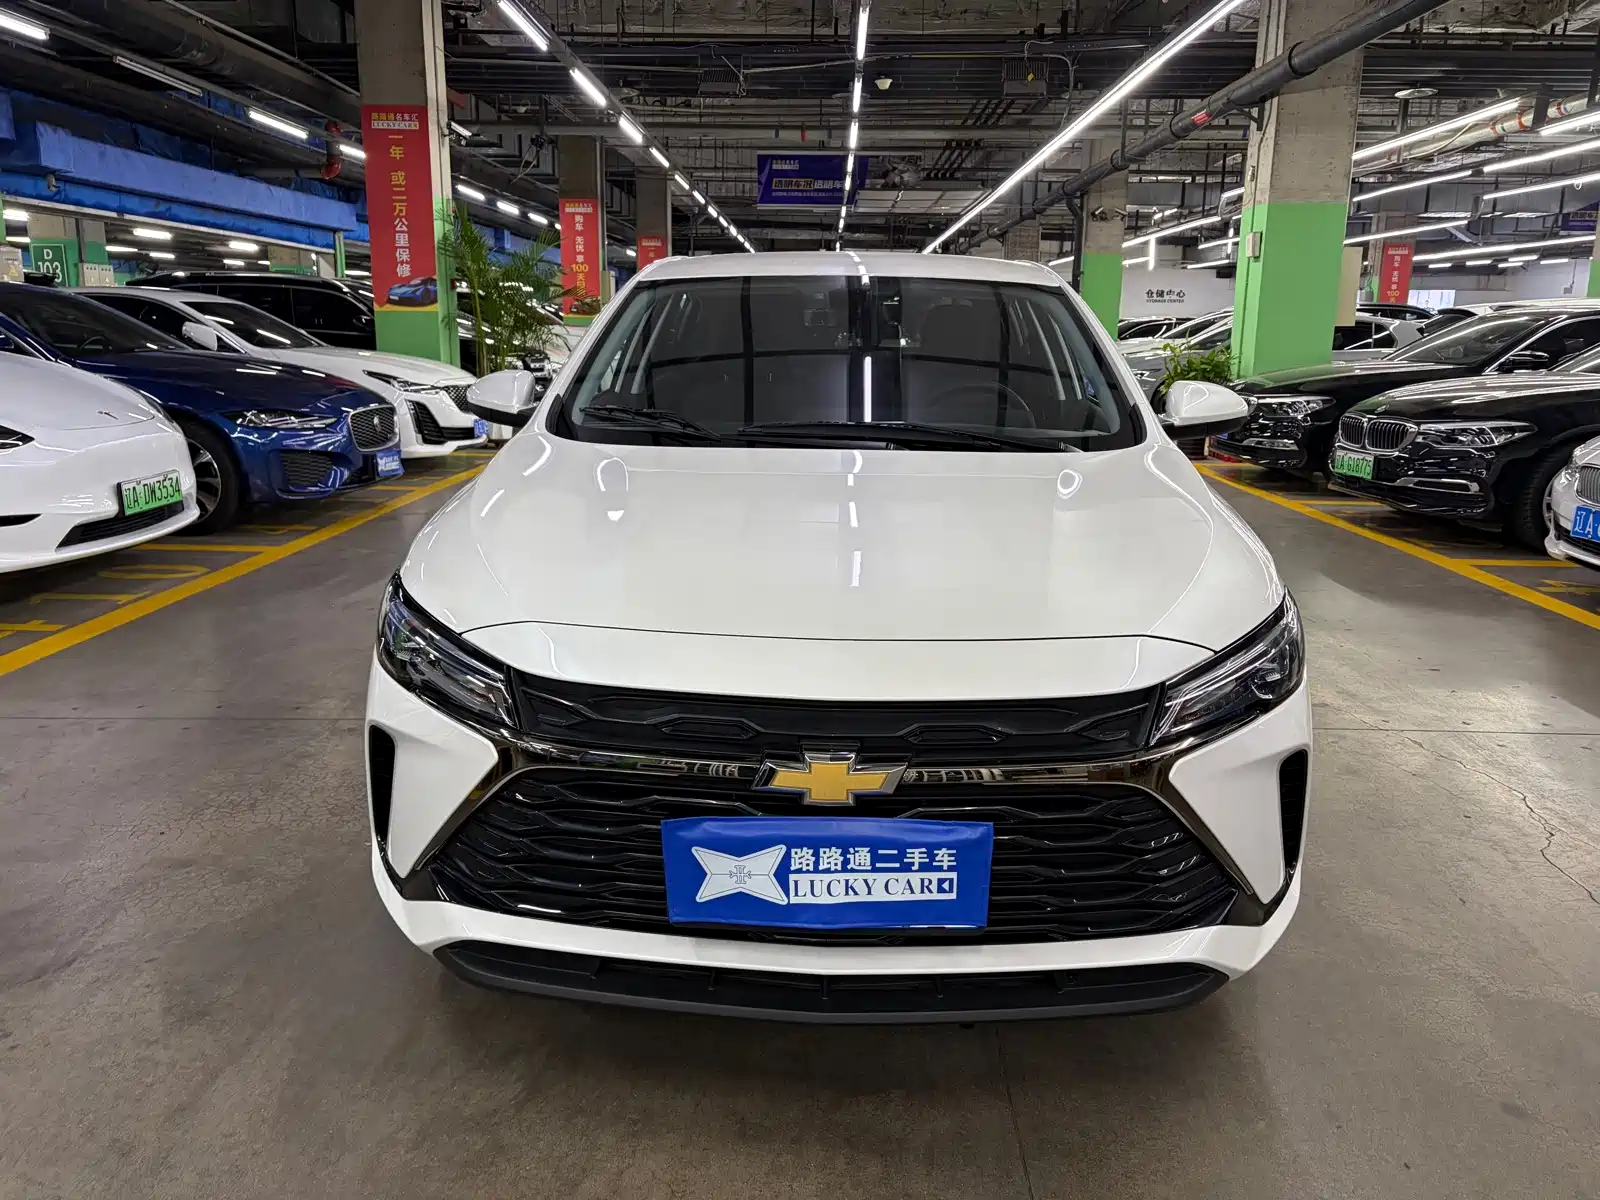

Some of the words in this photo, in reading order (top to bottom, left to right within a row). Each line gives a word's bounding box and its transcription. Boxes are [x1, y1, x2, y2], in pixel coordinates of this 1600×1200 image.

[390, 171, 412, 277] 或二万公里保修
[43, 248, 53, 260] D
[1145, 289, 1186, 299] 仓储中心
[789, 847, 957, 872] 路路通二手车
[793, 878, 877, 899] LUCKY
[884, 876, 934, 897] CAR
